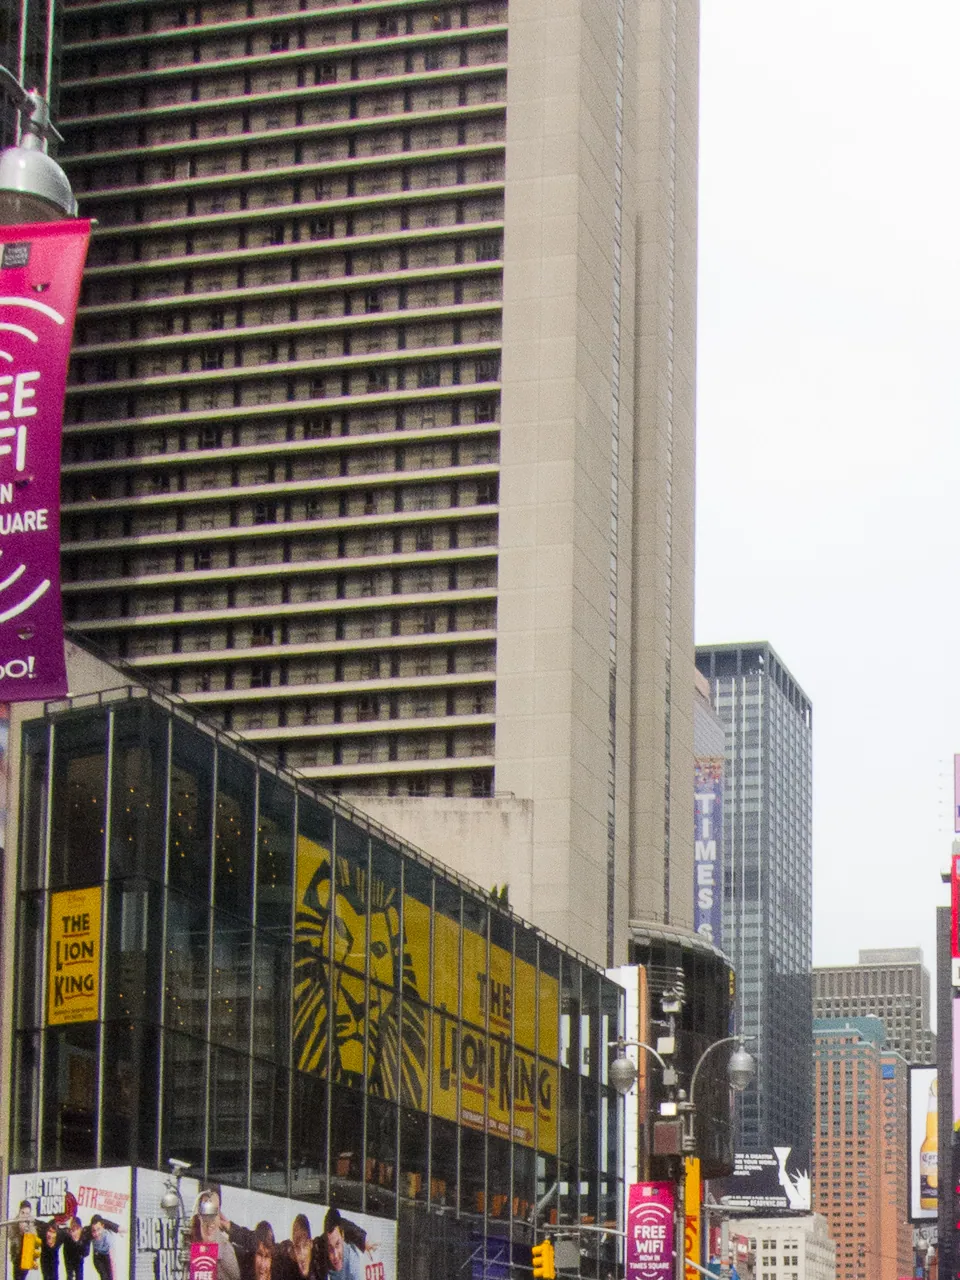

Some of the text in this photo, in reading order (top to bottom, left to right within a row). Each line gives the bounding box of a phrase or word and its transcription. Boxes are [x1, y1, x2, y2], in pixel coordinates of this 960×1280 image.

[694, 793, 716, 910] TIMES
[62, 913, 90, 933] THE
[56, 940, 94, 971] LION
[55, 974, 94, 1007] KING
[477, 972, 511, 1021] THE
[439, 1003, 495, 1091] LION
[499, 1031, 551, 1111] KING
[78, 1186, 98, 1208] BTR
[634, 1225, 666, 1239] FREE
[635, 1240, 663, 1253] WIFI
[195, 1271, 213, 1280] FREE
[648, 1262, 669, 1270] SQUARE
